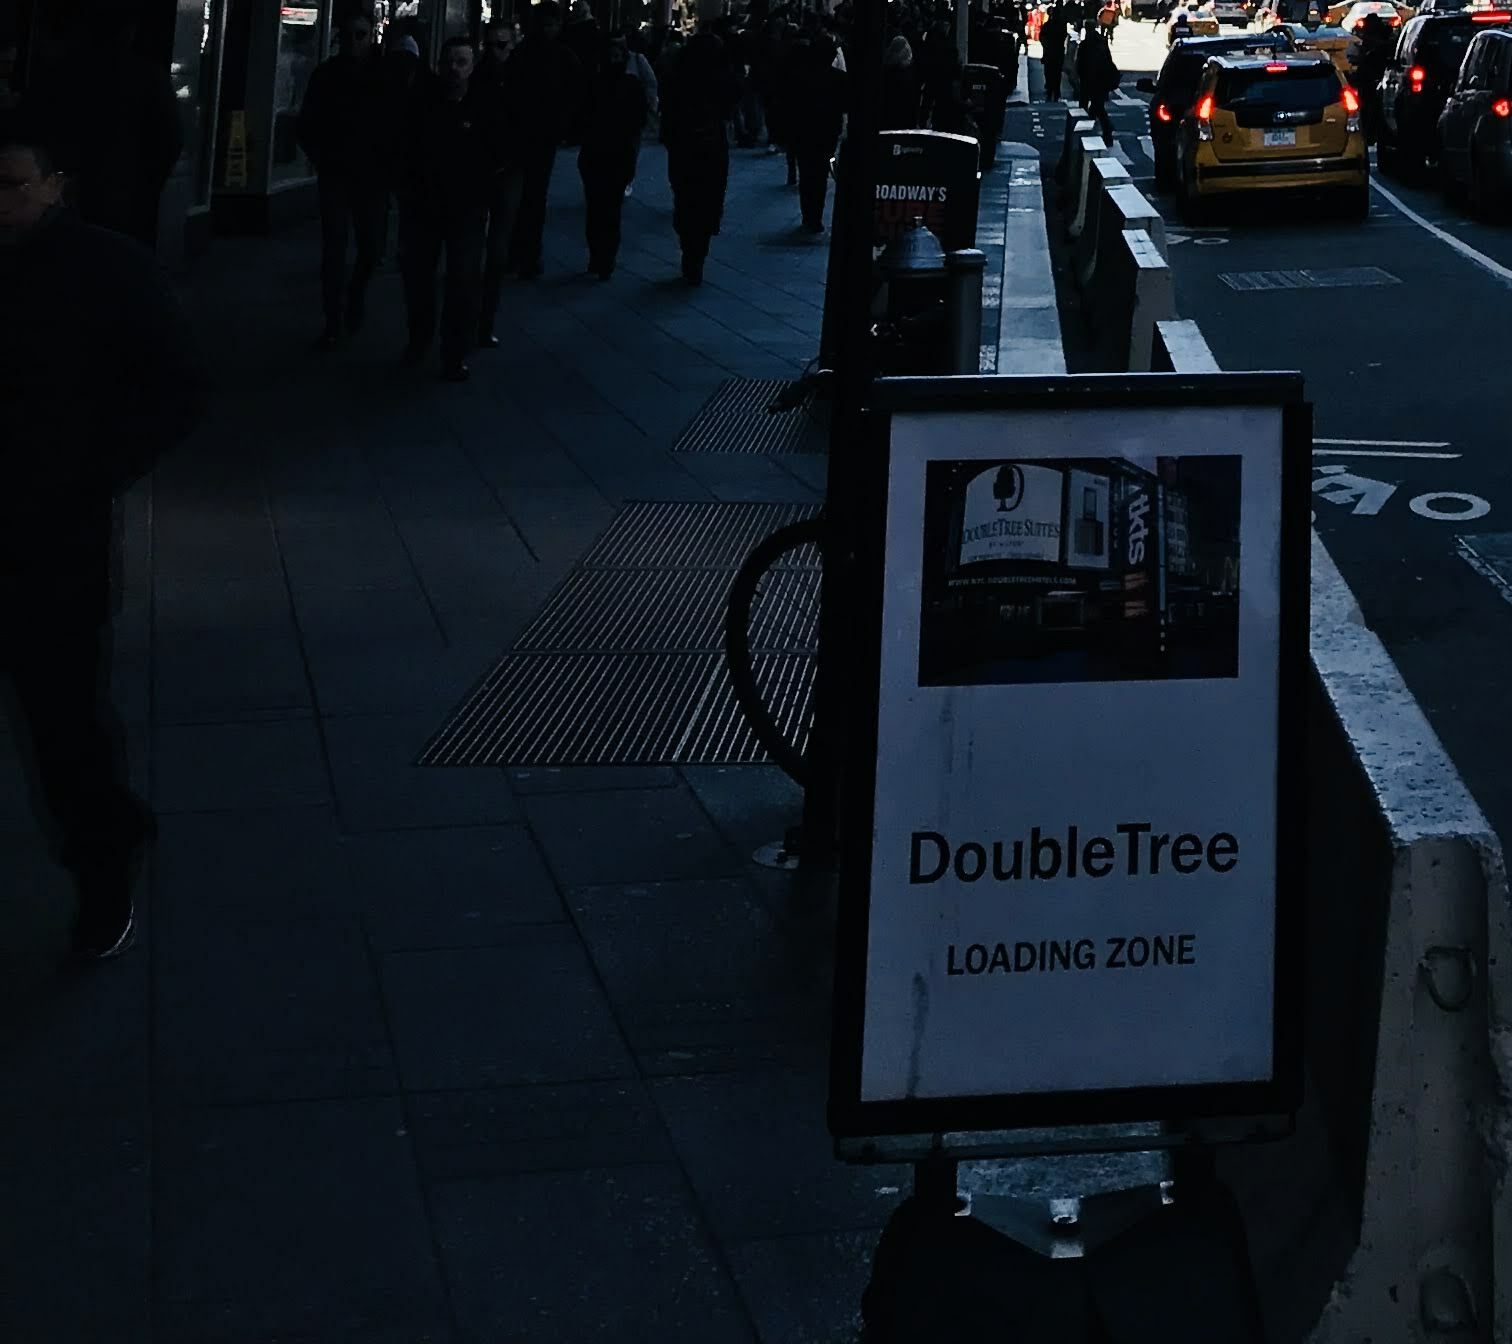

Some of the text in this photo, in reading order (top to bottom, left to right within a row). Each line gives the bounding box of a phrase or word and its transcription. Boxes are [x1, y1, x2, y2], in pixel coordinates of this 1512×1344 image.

[875, 184, 948, 202] OADWAY'S
[909, 821, 1240, 887] DoubleTree
[946, 934, 1197, 977] LOADING ZONE
